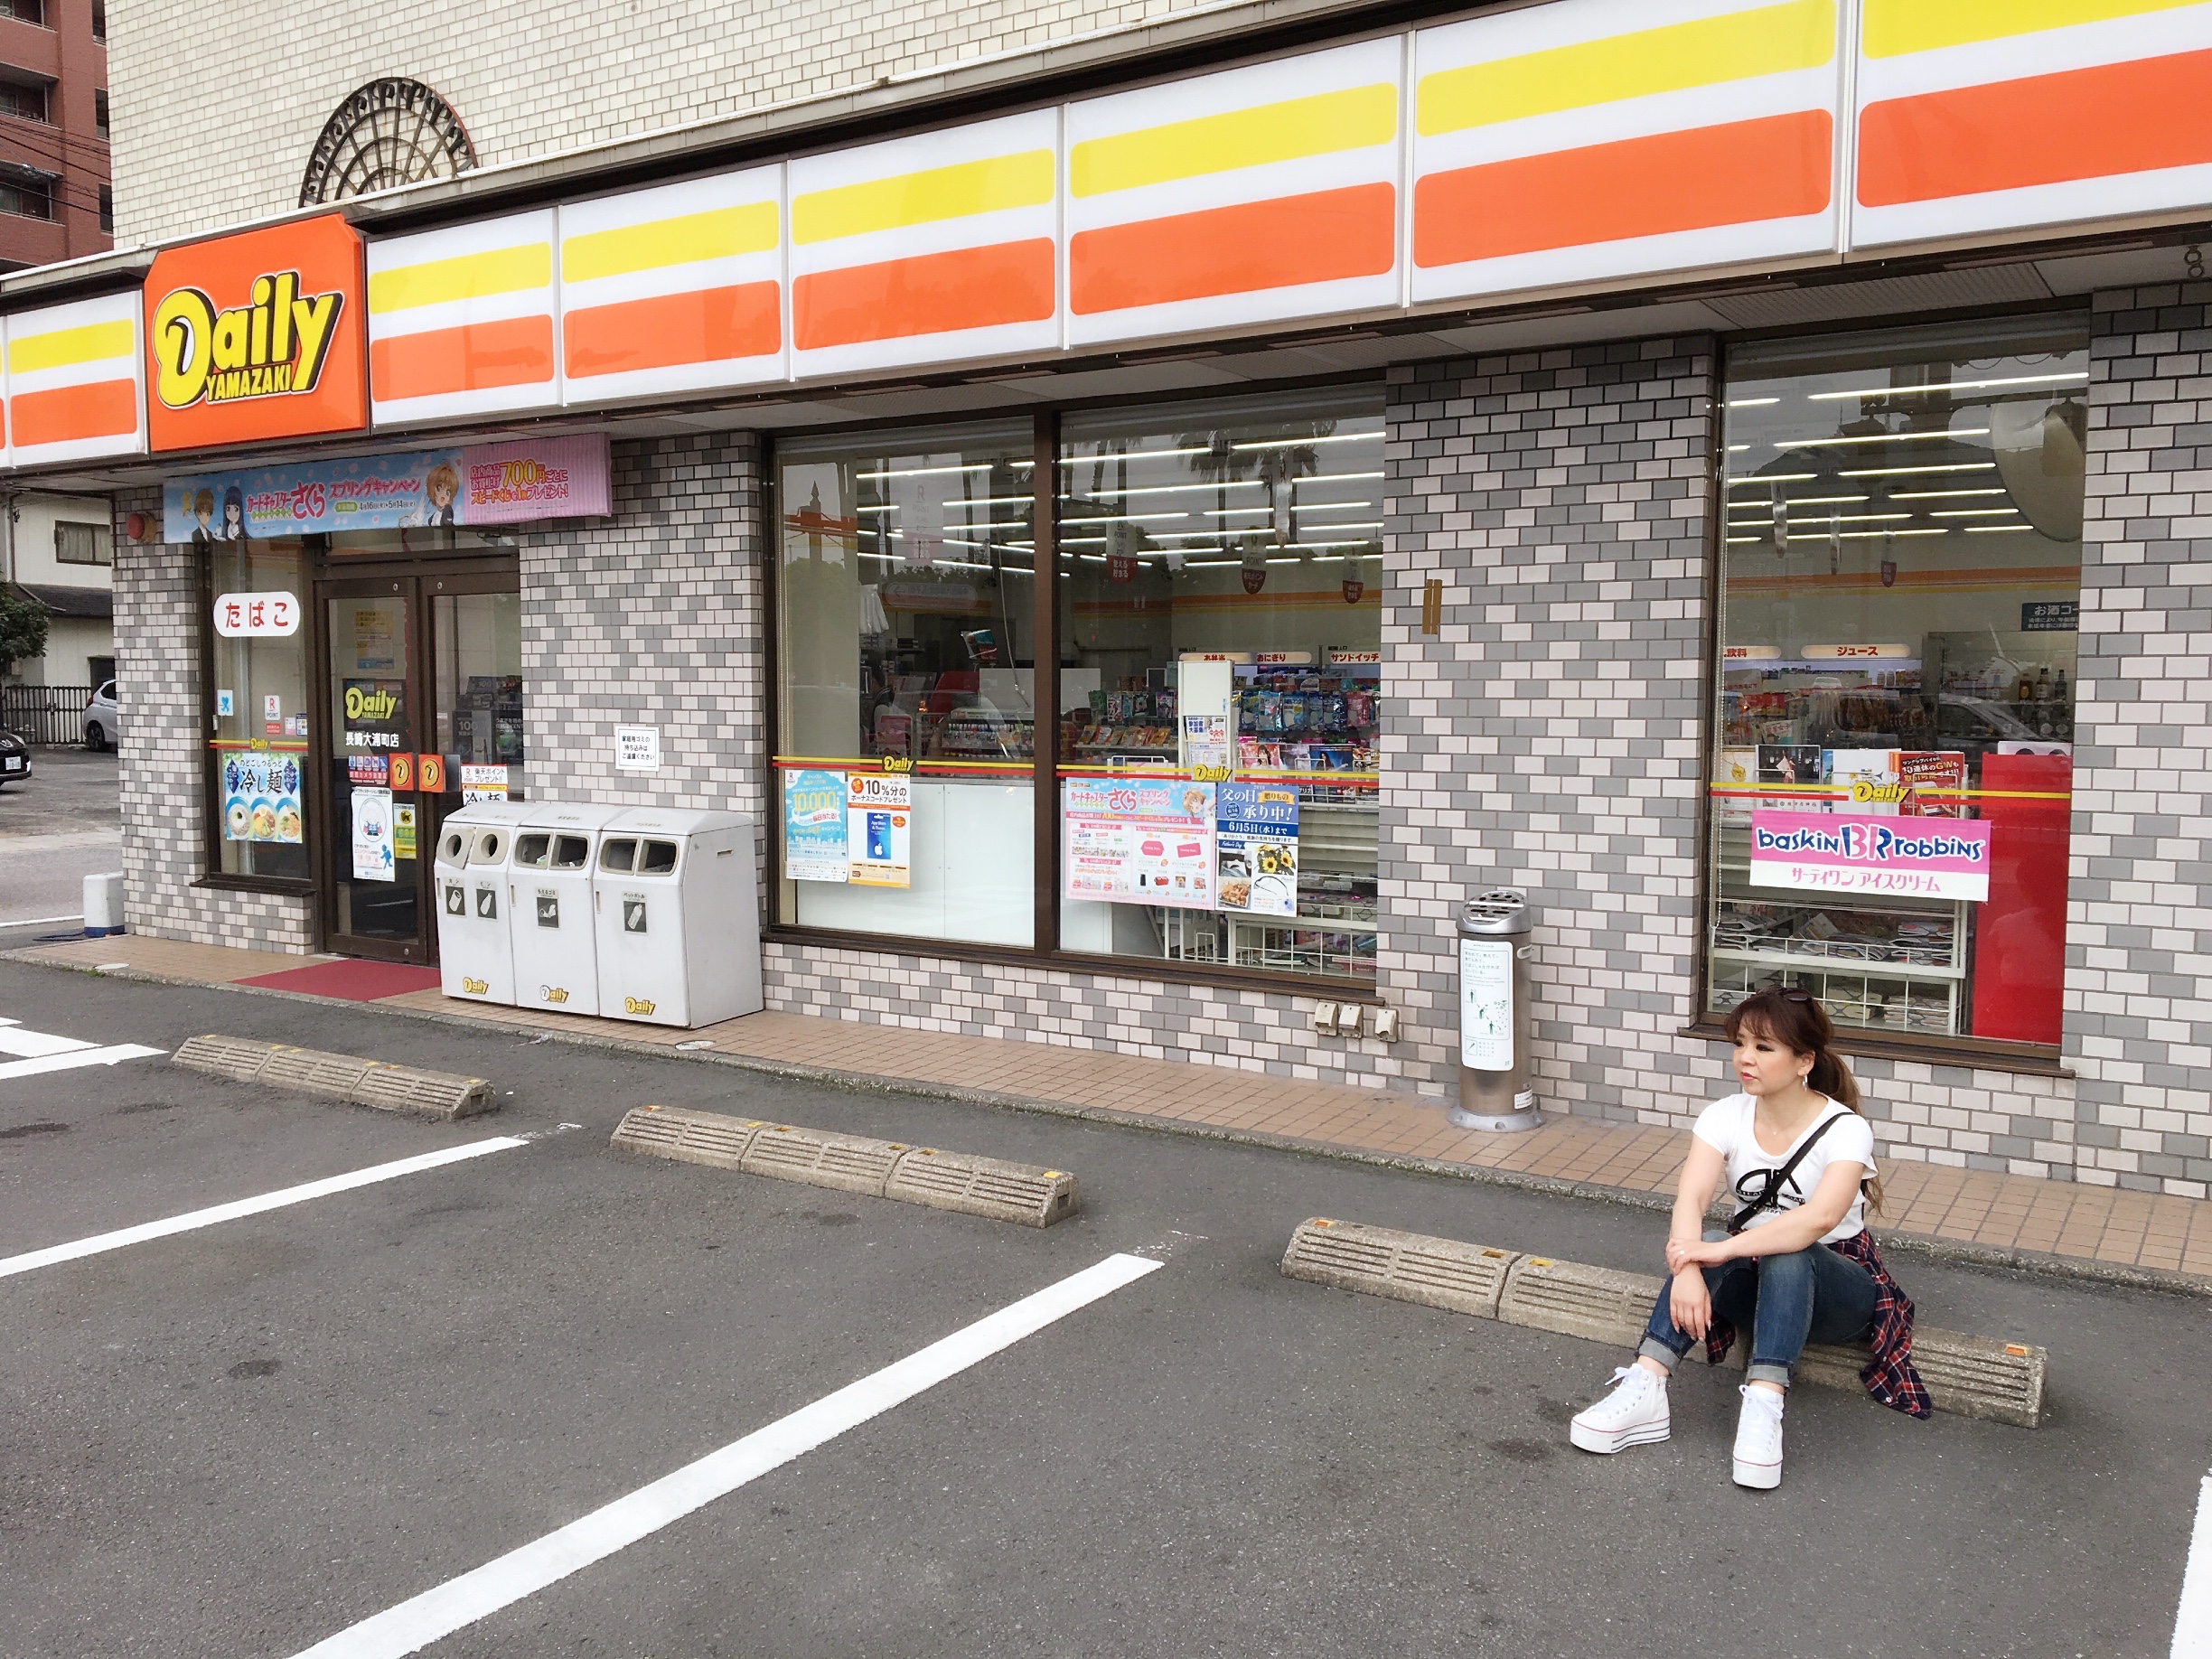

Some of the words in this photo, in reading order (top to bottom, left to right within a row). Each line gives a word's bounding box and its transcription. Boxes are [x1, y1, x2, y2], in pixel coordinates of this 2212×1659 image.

[154, 271, 342, 407] Daily
[206, 364, 292, 400] YAMAZAKI
[329, 475, 421, 500] スプリングキャンペーン
[291, 482, 325, 519] さくら
[226, 600, 288, 628] たばこ
[1257, 653, 1286, 662] おにぎり
[1331, 652, 1380, 662] サンドイッチ
[1837, 646, 1878, 656] ジュース
[346, 688, 397, 718] Daily
[345, 732, 399, 747] 長崎大浦町店
[885, 756, 914, 771] Daily
[239, 768, 283, 793] 冷し麺
[1194, 764, 1233, 782] Daily
[851, 795, 907, 803] ボーナスコードプレゼント
[1108, 788, 1137, 811] さくら
[1139, 789, 1170, 798] スプリング
[1222, 788, 1255, 802] 父の日
[1264, 792, 1289, 801] 贈りもの
[1853, 781, 1911, 802] Daily
[1139, 797, 1172, 806] キャンペーン
[1243, 804, 1293, 820] 承り中!
[1229, 821, 1288, 834] 6月5日(水)まで
[1757, 829, 1838, 853] baskin
[1897, 838, 1982, 861] robbins
[1792, 867, 1855, 886] サーティワン
[1862, 871, 1941, 892] アイスクリーム
[463, 977, 489, 994] Daily
[539, 985, 569, 1003] Daily
[624, 997, 655, 1016] Daily
